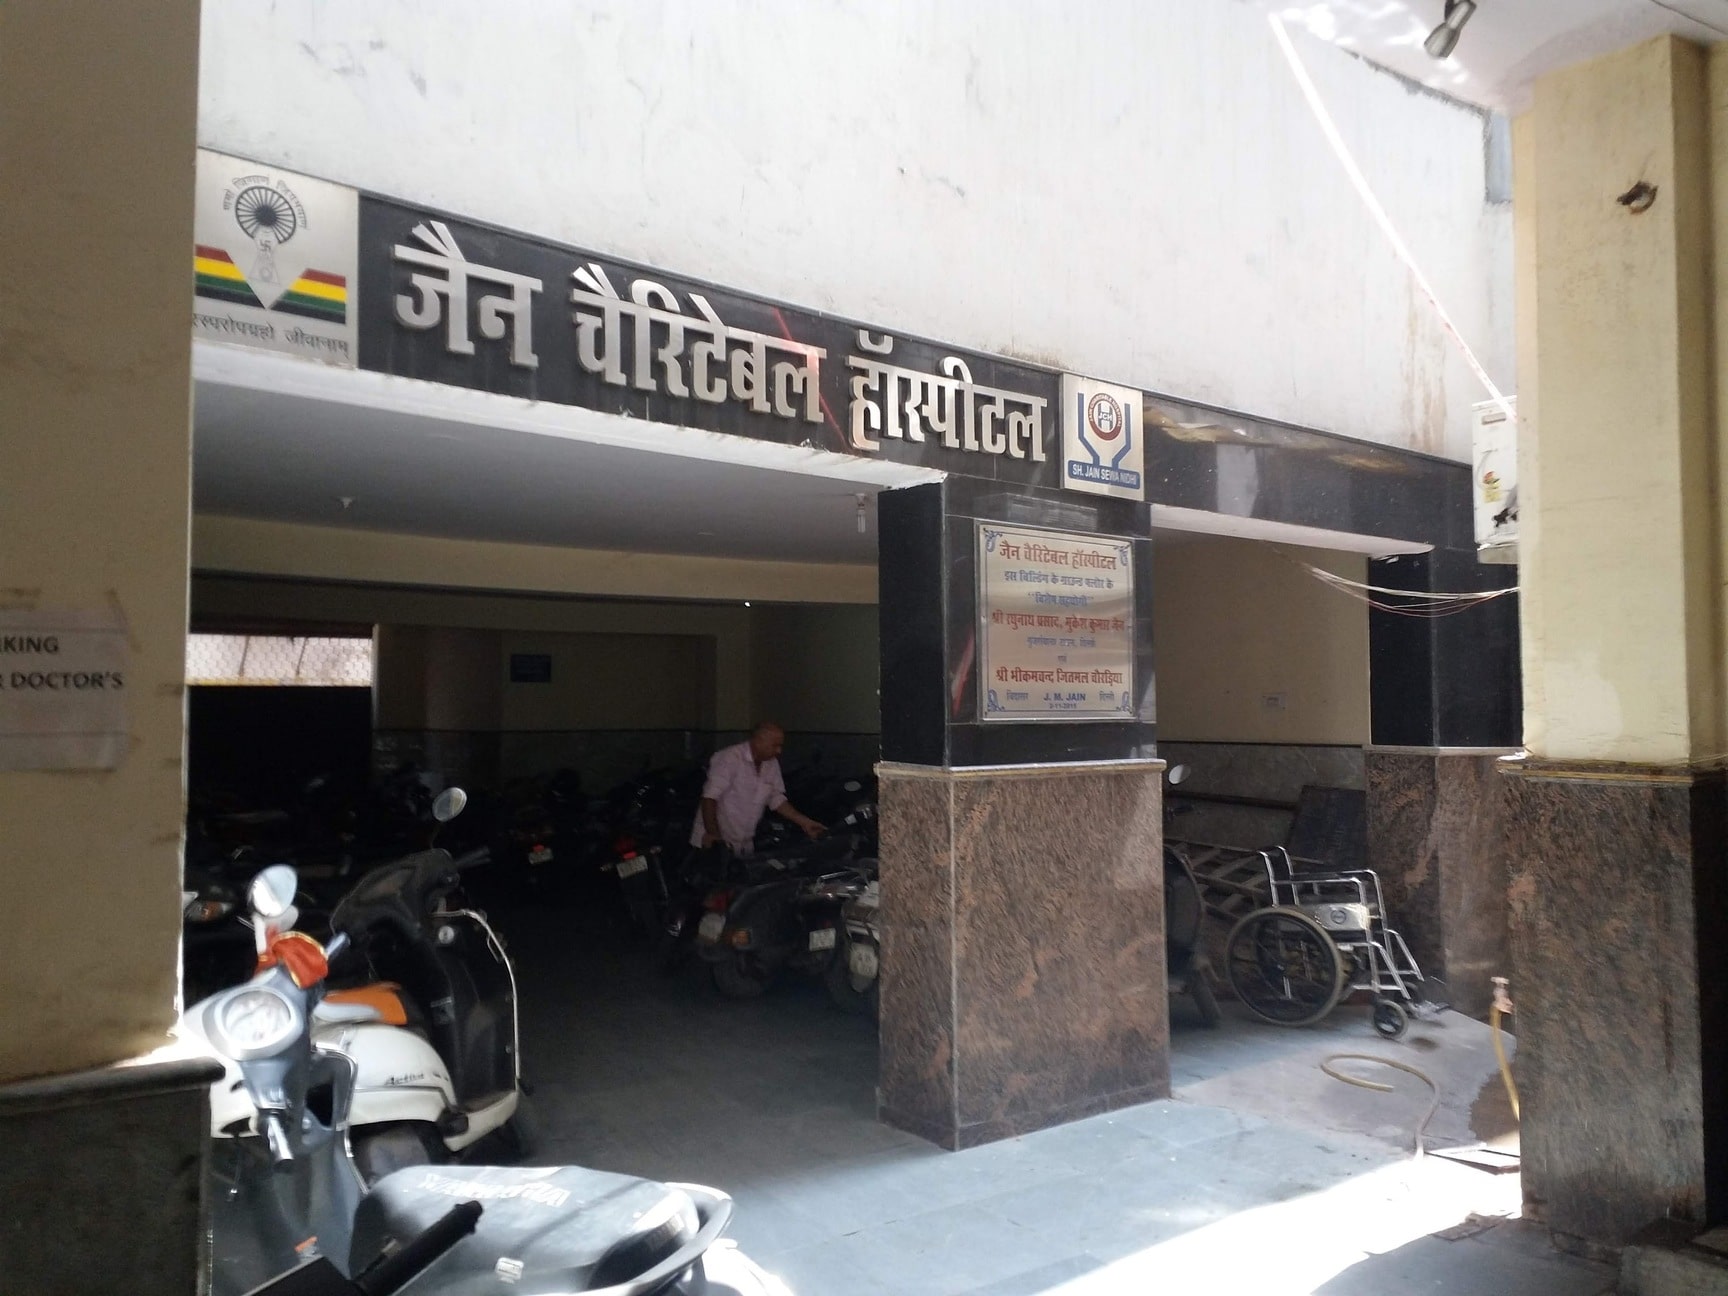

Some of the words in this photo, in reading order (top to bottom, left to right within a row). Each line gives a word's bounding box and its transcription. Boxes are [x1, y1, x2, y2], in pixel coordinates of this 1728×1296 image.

[393, 220, 543, 369] जैन
[571, 262, 827, 424] चैरिटेबल
[845, 328, 1048, 462] हॉस्पीटल
[1072, 463, 1084, 476] SH.
[1085, 465, 1100, 479] JAIN
[999, 540, 1020, 562] जैन
[1024, 542, 1069, 566] चैरिटेबल
[1072, 549, 1117, 570] हॉस्पीटल
[1004, 569, 1017, 582] इस
[1050, 571, 1059, 584] के
[1106, 577, 1114, 589] के
[992, 608, 1003, 624] श्री
[0, 636, 60, 653] KING
[11, 671, 124, 690] DOCTOR'S
[996, 666, 1008, 683] श्री
[1056, 668, 1089, 684] जितमल
[1066, 692, 1086, 702] JAIN
